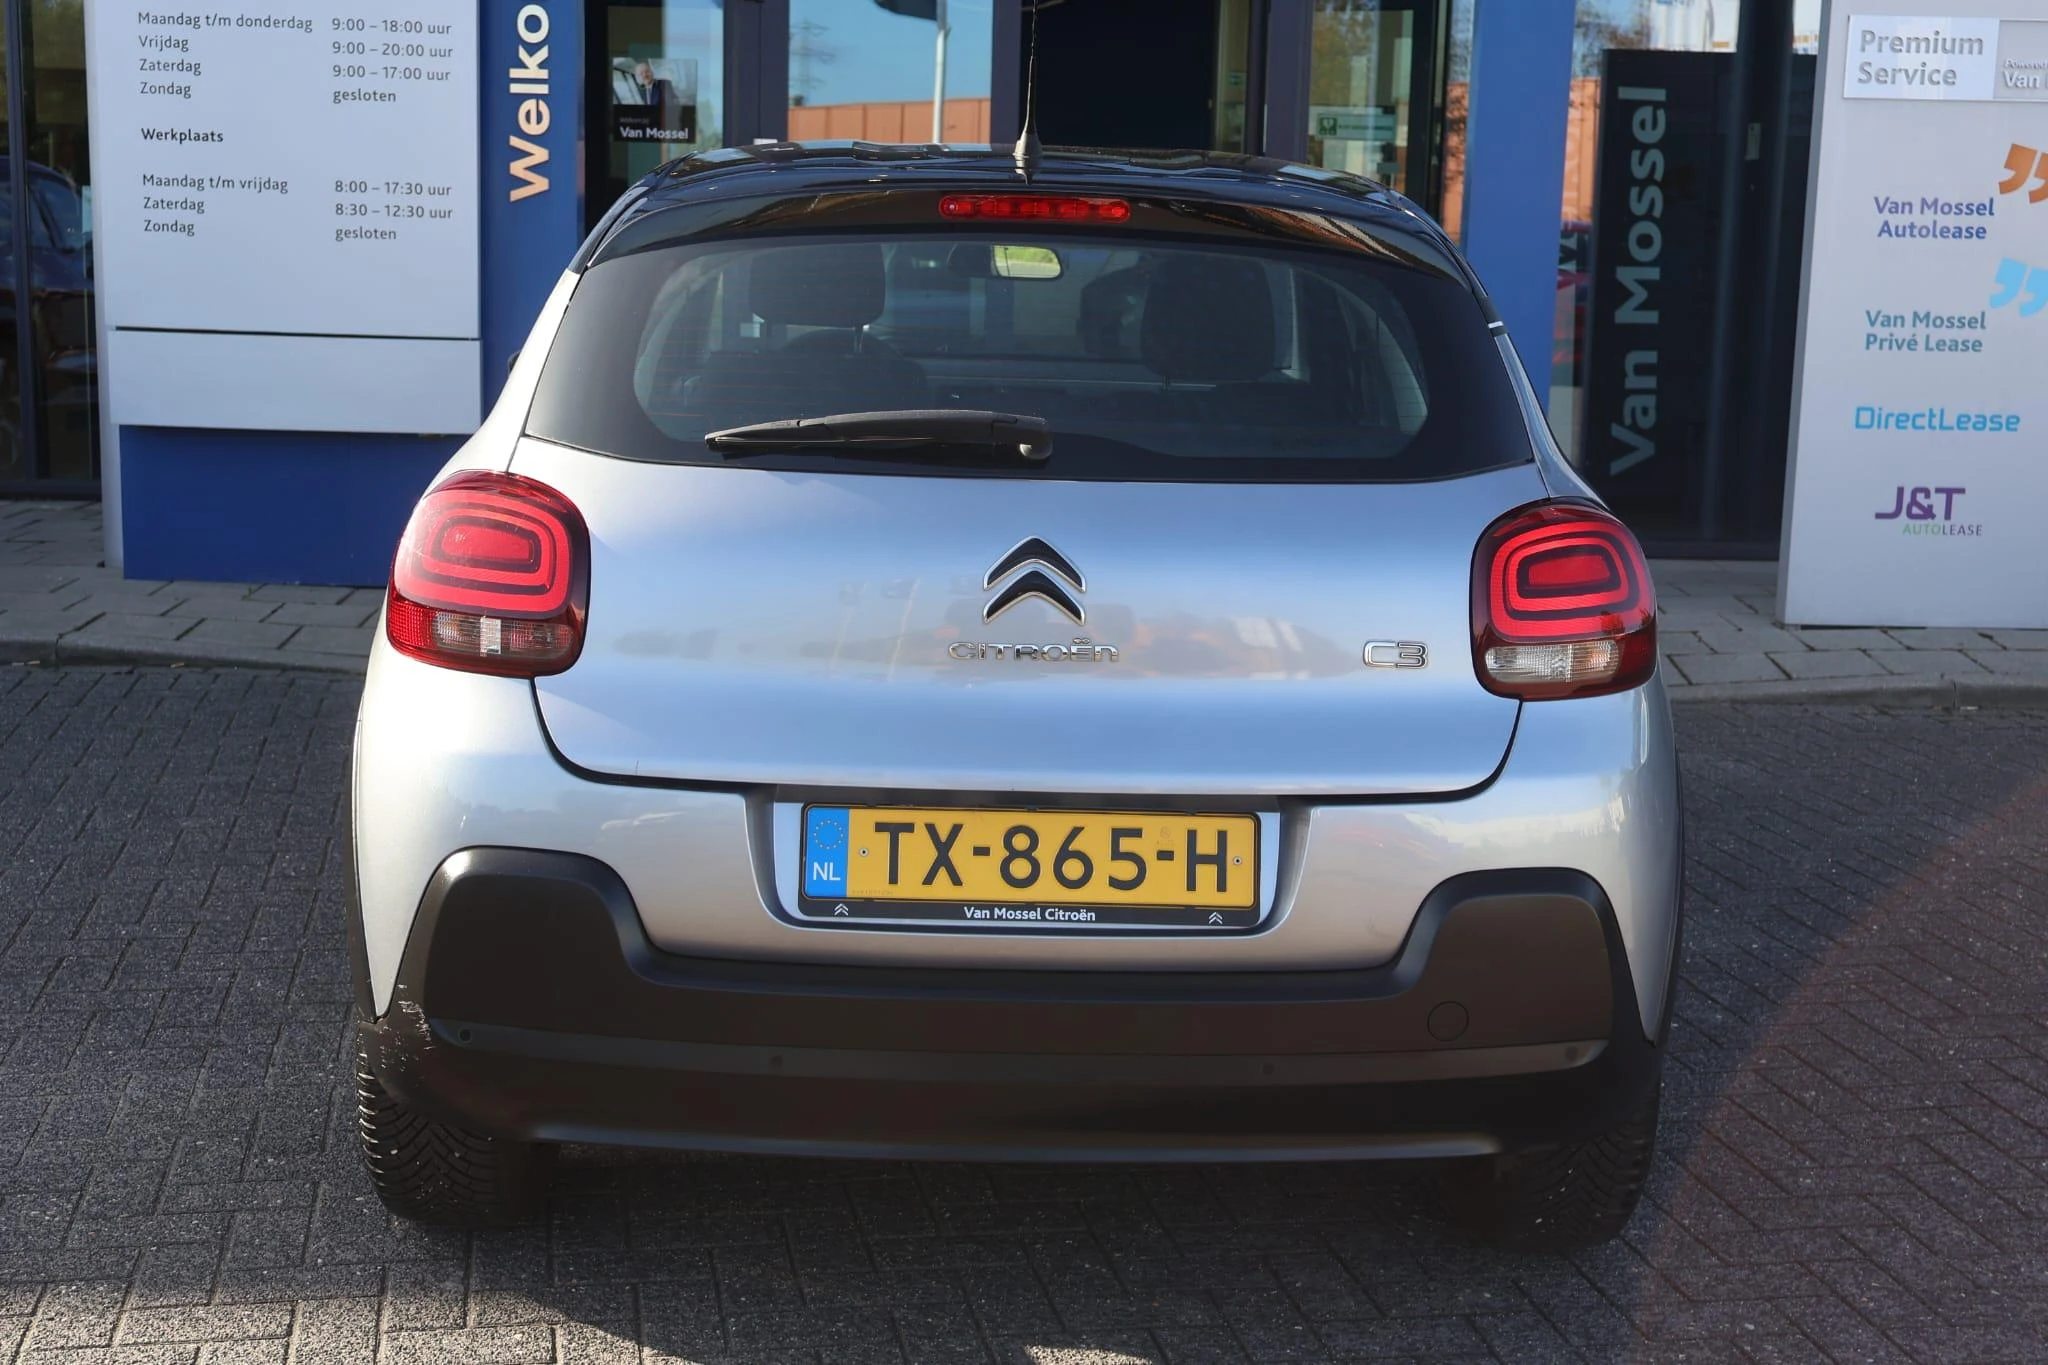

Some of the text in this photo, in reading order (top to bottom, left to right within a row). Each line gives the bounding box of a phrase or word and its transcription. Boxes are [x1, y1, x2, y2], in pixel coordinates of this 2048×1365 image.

[138, 12, 313, 33] Maandag t/m donderdag
[332, 18, 365, 31] 9:00
[382, 20, 423, 34] 18:00
[427, 24, 452, 34] uur
[138, 35, 189, 52] Vrijdag
[332, 41, 365, 55] 9:00
[382, 43, 424, 57] 20:00
[429, 48, 453, 58] uur
[1860, 29, 1983, 56] Premium
[139, 58, 202, 76] Zaterdag
[333, 65, 365, 78] 9:00
[382, 66, 422, 80] 17:00
[427, 71, 451, 81] uur
[1857, 61, 1957, 86] Service
[2002, 70, 2040, 89] Van
[140, 81, 192, 99] Zondag
[333, 88, 397, 104] gesloten
[509, 4, 550, 202] Welko
[141, 127, 224, 145] Werkplaats
[620, 126, 689, 139] Van Mossel
[143, 174, 288, 194] Maandag t/m vrijdag
[335, 180, 367, 193] 8:00
[384, 182, 423, 196] 17:30
[428, 186, 452, 196] uur
[143, 197, 205, 214] Zaterdag
[335, 203, 367, 216] 8:30
[384, 205, 424, 218] 12:30
[429, 208, 453, 219] uur
[1873, 196, 1995, 216] Van Mossel
[144, 219, 195, 237] Zondag
[335, 226, 396, 242] gesloten
[1877, 220, 1987, 240] Autolease
[1610, 86, 1667, 476] Van Mossel
[1865, 310, 1987, 330] Van Mossel
[1865, 333, 1983, 353] Privé Lease
[1854, 406, 2021, 432] DirectLease
[1874, 486, 1966, 521] J&T
[1902, 523, 1983, 537] AUTOLEASE
[1362, 639, 1429, 669] C3
[874, 821, 1228, 893] TX-865-H
[812, 861, 841, 882] NL
[964, 906, 1096, 922] Van Mossel Citroën
